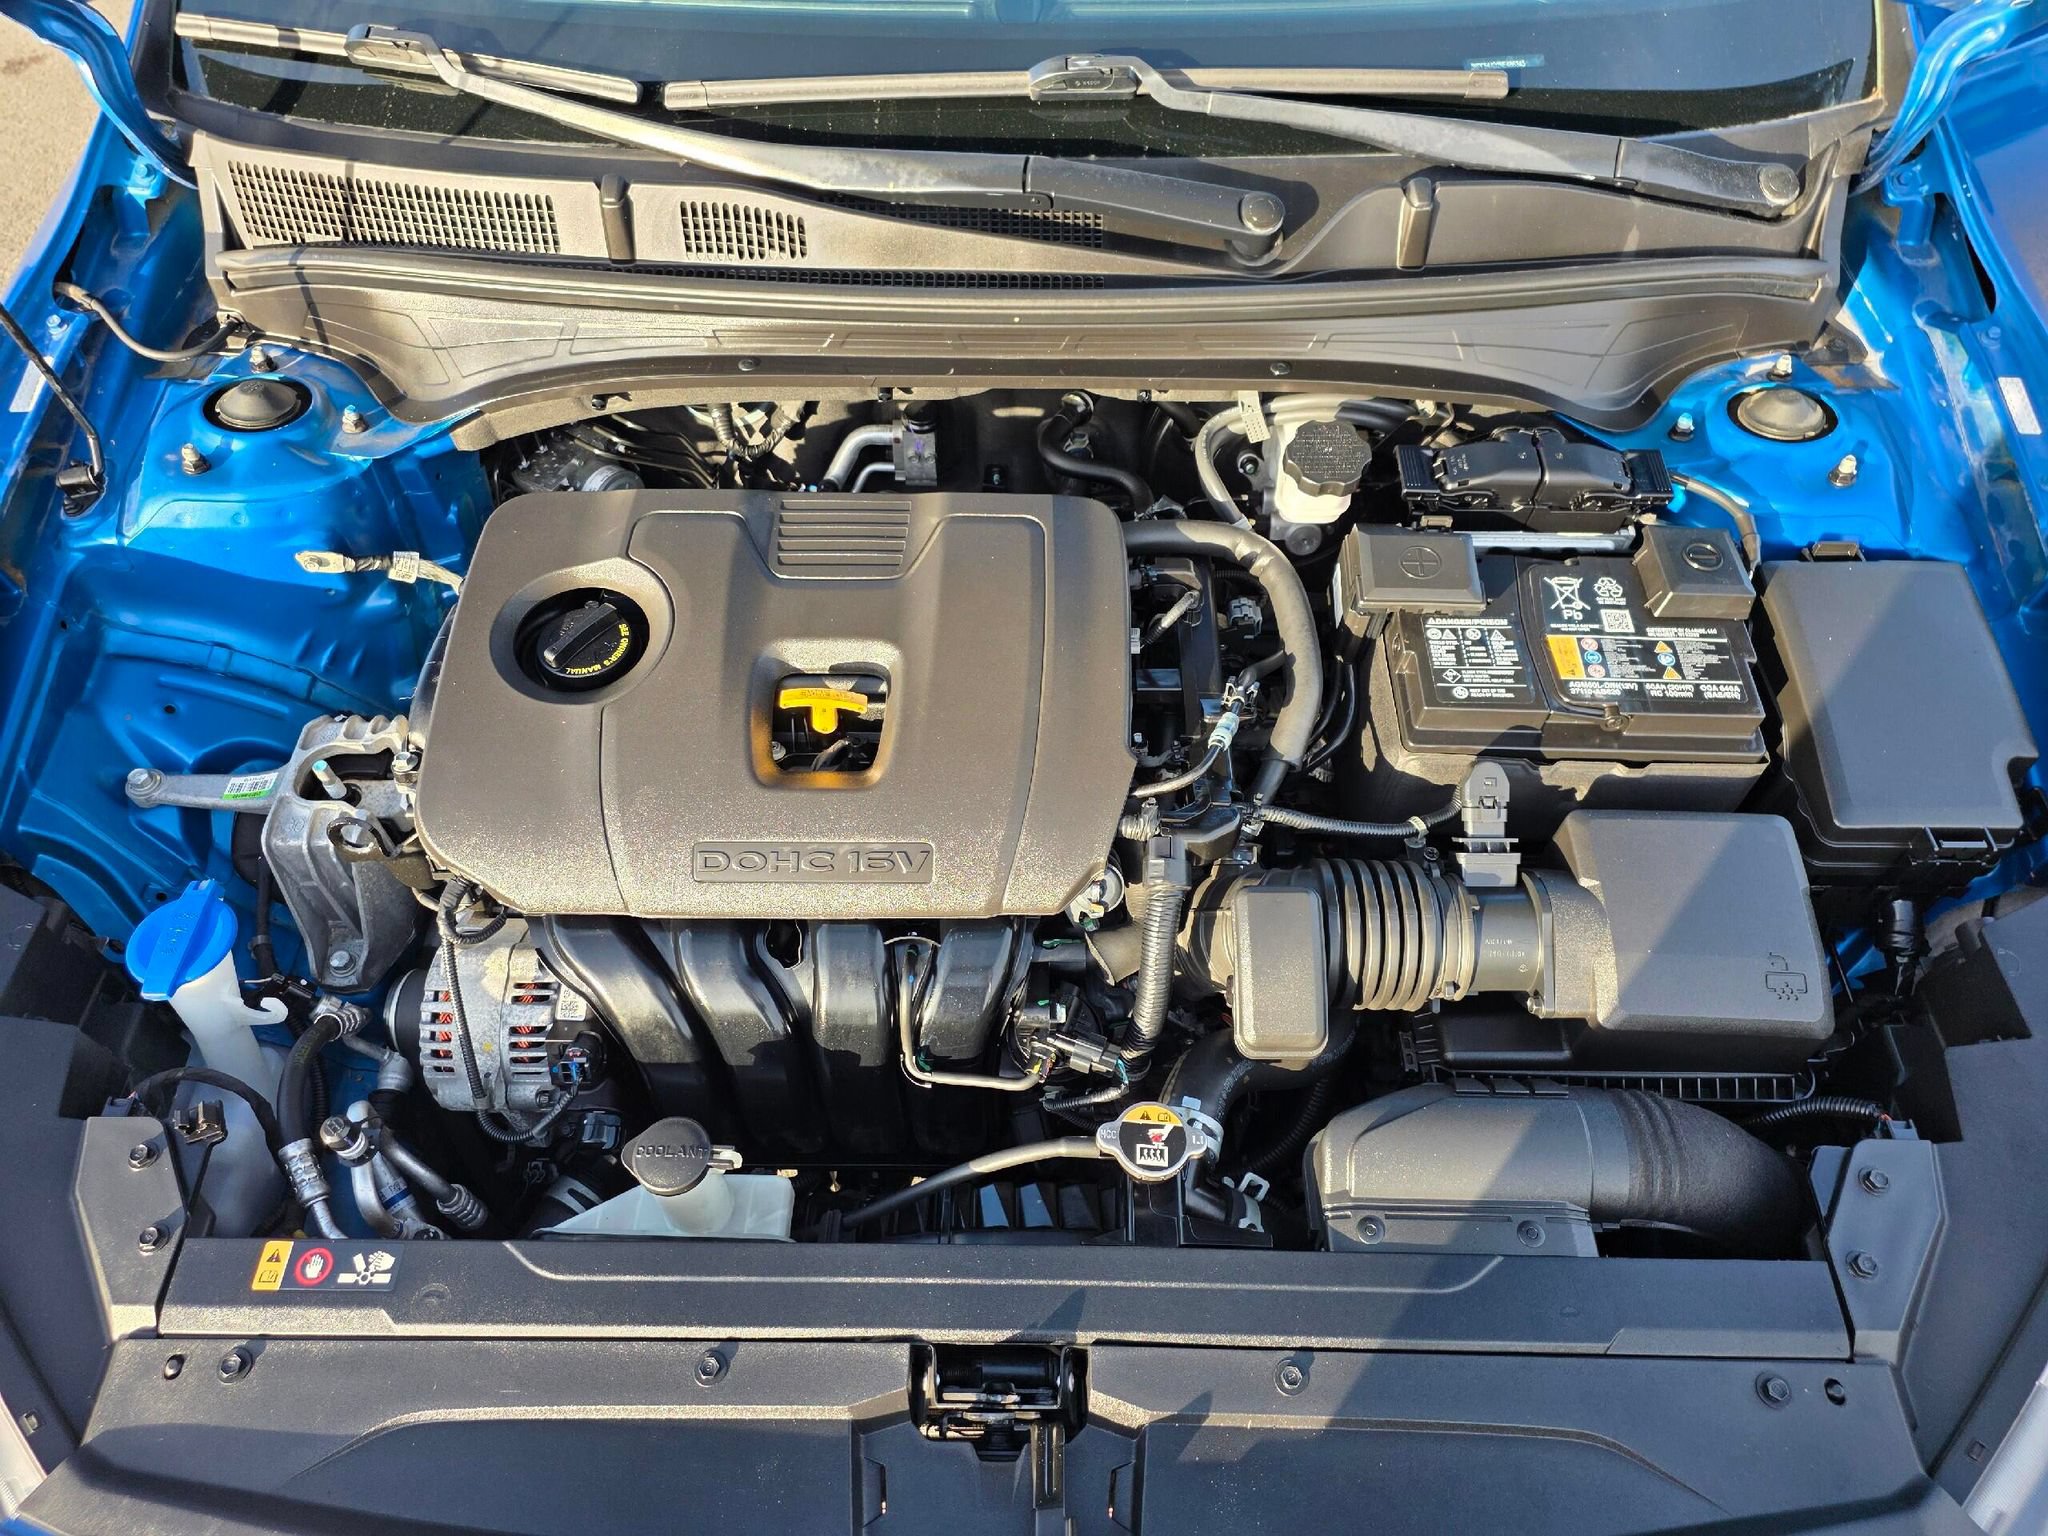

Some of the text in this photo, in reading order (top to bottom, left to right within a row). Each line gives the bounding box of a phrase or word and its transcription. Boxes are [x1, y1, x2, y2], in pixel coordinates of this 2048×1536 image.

[1562, 609, 1584, 621] Pb
[566, 623, 630, 675] SEE OWNER'S MANUAL
[697, 850, 931, 874] DOHC 16V
[635, 1144, 708, 1160] COOLANT
